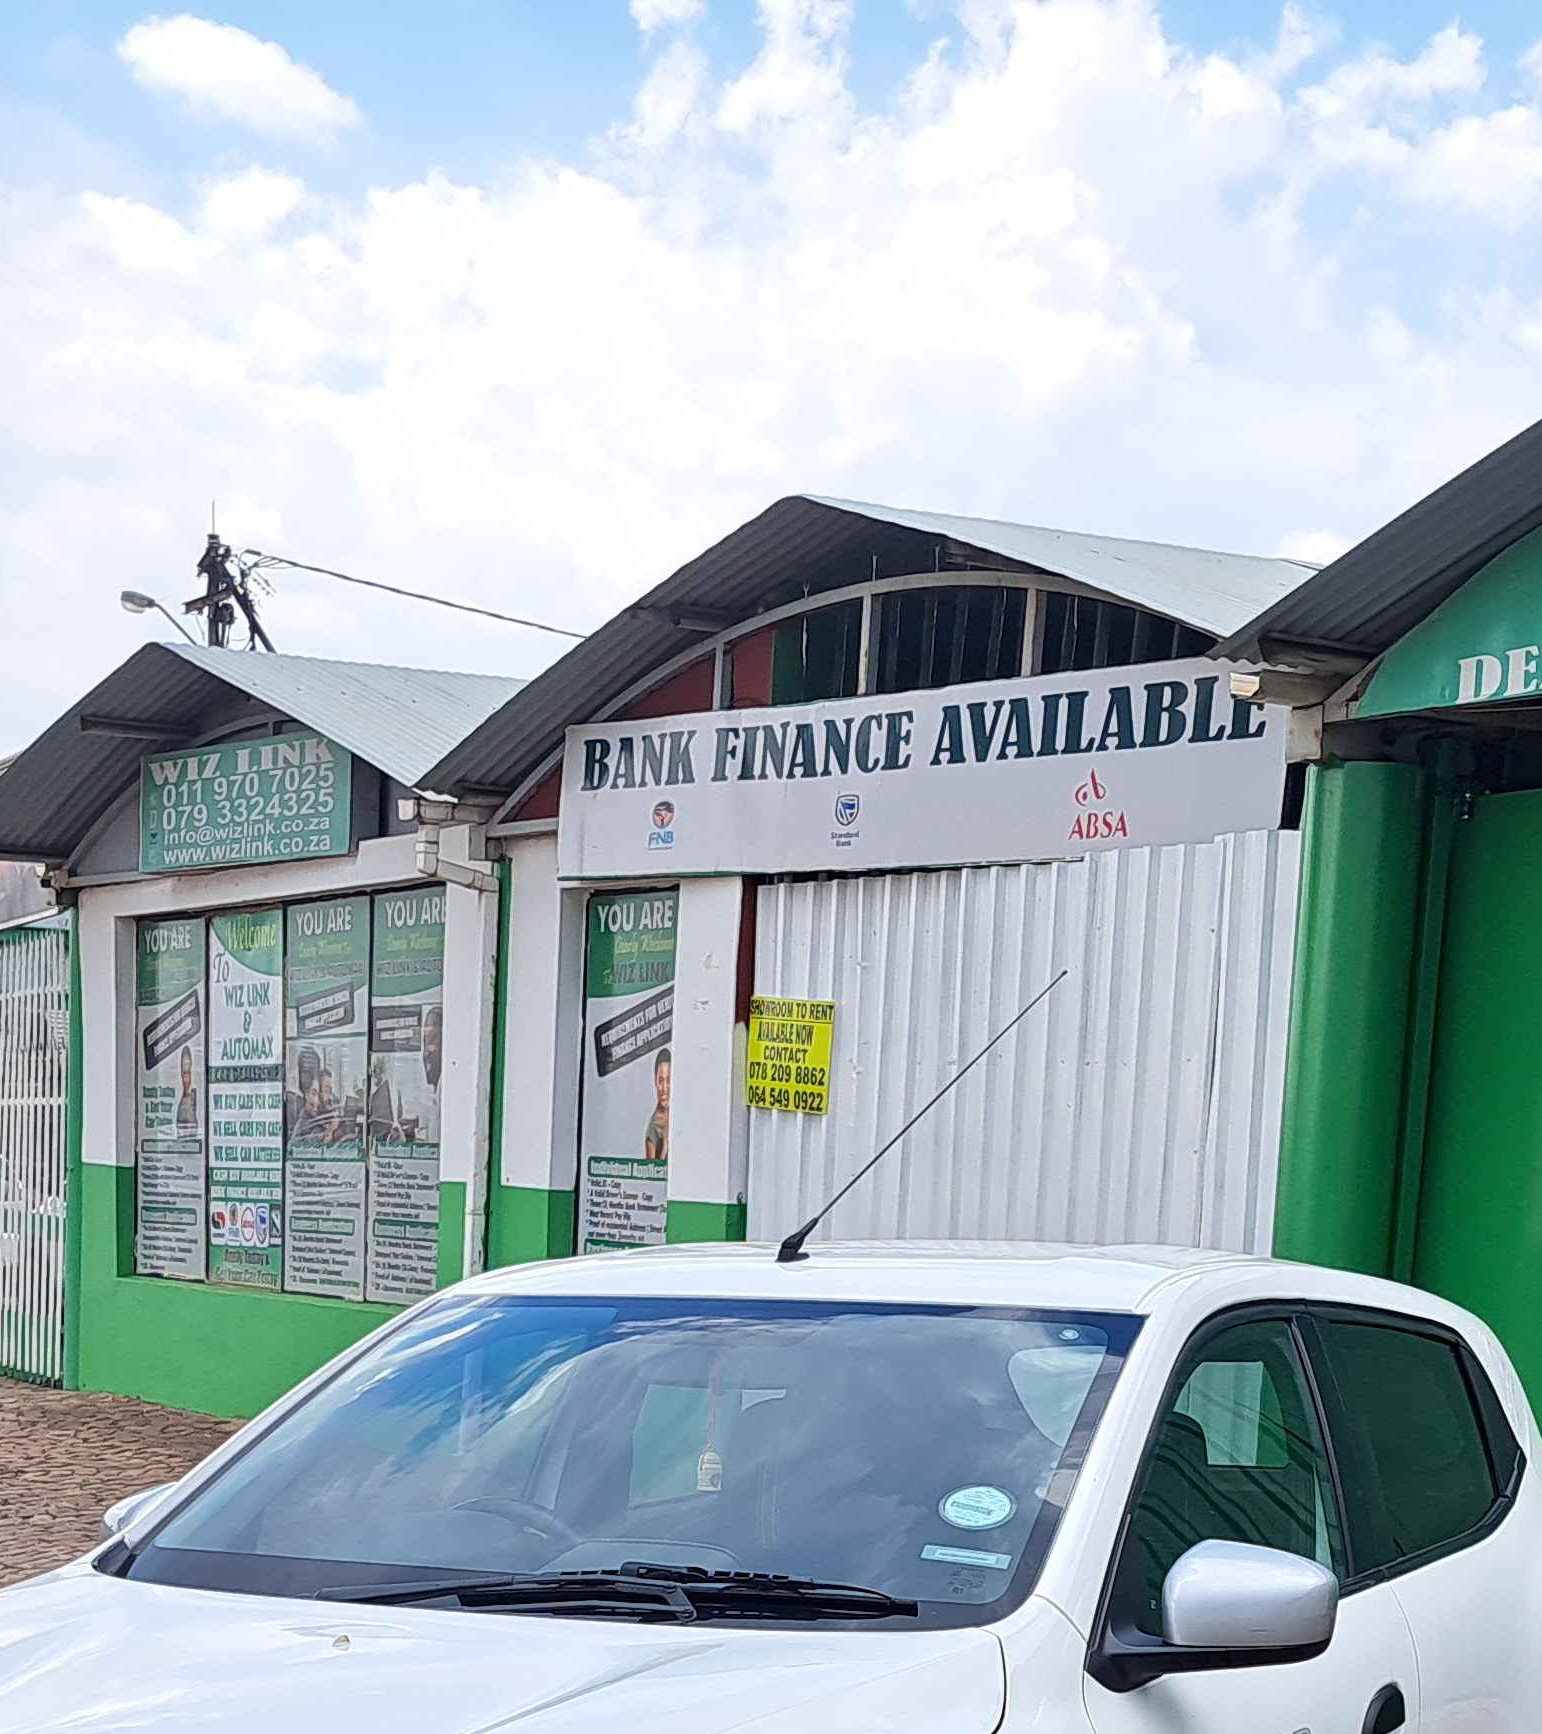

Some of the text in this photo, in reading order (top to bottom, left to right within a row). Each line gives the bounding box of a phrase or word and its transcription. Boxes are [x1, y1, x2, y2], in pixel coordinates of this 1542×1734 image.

[580, 676, 1267, 791] BANK FINANCE AVAILABLE
[148, 737, 335, 786] WIZ LINK
[163, 762, 334, 807] 011 970 7025
[162, 788, 334, 830] 079 3324325
[164, 815, 330, 846] info@wizlink.co.za
[648, 831, 674, 846] FNB
[1068, 810, 1129, 840] ABSA
[163, 834, 331, 865] www.wizlink.co.za
[295, 906, 352, 936] YOU ARE
[385, 898, 416, 928] YOU
[597, 899, 674, 933] YOU ARE
[144, 925, 192, 953] YOU ARE
[225, 917, 277, 951] Welcome
[213, 952, 230, 983] To
[612, 962, 636, 984] WIZ
[638, 961, 669, 983] LINK
[224, 982, 271, 1008] WIZ LINK
[750, 999, 834, 1021] SHOWROOM TO RENT
[758, 1021, 814, 1046] AVAILABLE NOW
[221, 1037, 274, 1061] AUTOMAX
[763, 1045, 808, 1064] CONTACT
[749, 1062, 826, 1086] 078 209 8862
[748, 1086, 824, 1112] 064 549 0922
